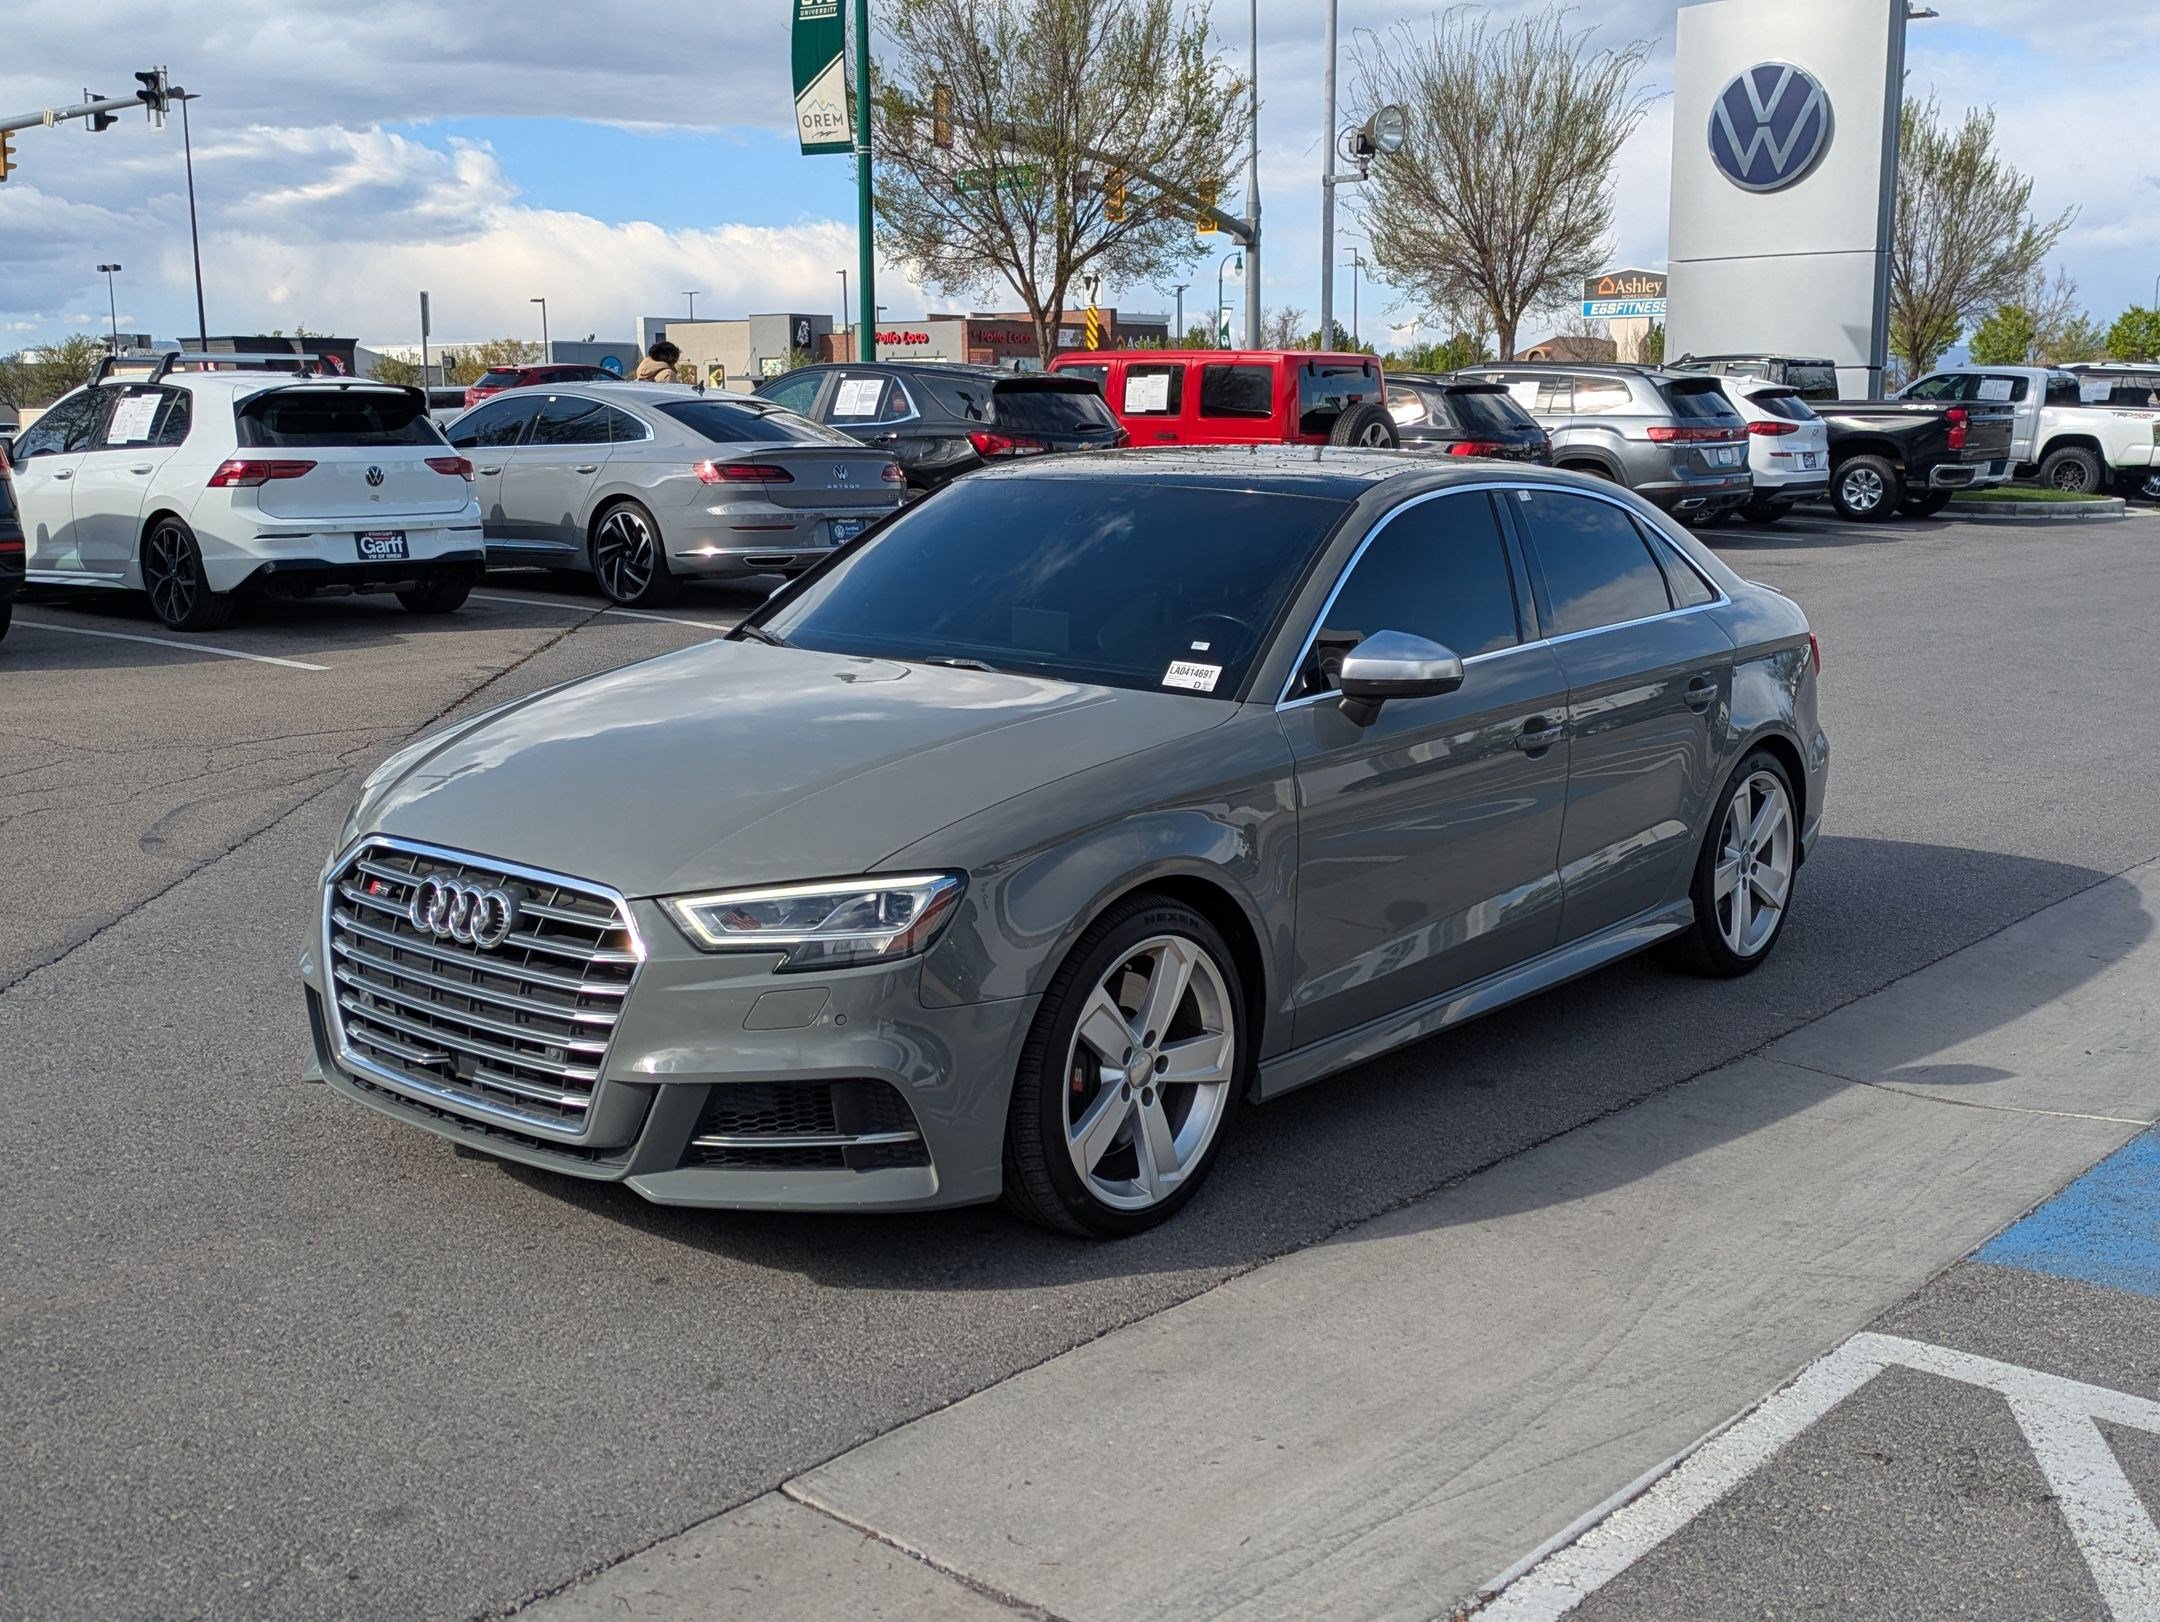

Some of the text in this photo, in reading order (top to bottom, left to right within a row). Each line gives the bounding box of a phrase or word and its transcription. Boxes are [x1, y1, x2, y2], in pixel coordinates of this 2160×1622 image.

[800, 6, 837, 16] UNIVERSITY
[802, 113, 844, 129] OREM
[1614, 276, 1663, 297] Ashley
[901, 331, 930, 345] Loco
[360, 536, 404, 554] Garff
[1169, 665, 1215, 679] LA041469T
[1193, 681, 1202, 689] D
[1143, 912, 1199, 929] NEXEN
